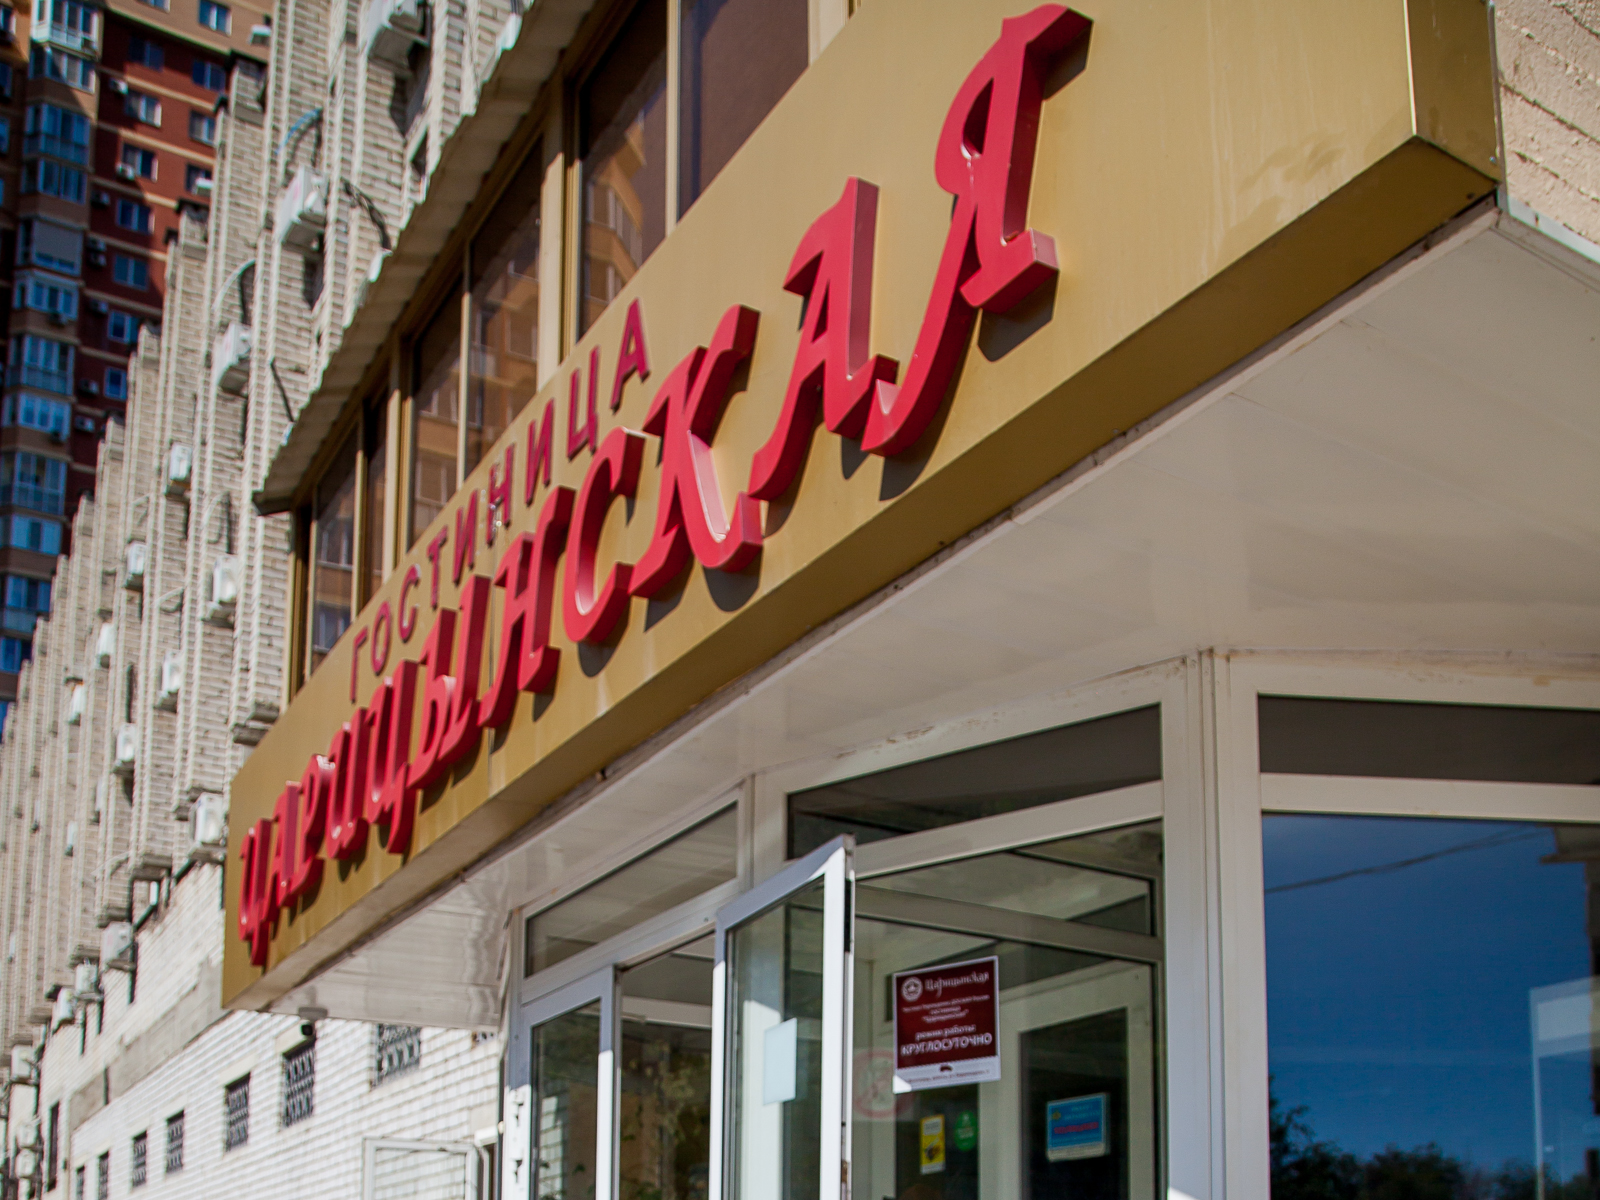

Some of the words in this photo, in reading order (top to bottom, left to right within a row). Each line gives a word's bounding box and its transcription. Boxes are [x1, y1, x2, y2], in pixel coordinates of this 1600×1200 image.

[239, 4, 1091, 966] ЦАРИЦЫНСКАЯ
[351, 298, 650, 702] ГОСТИНИЦА
[901, 1033, 992, 1056] КРУГЛОСУТОЧНО
